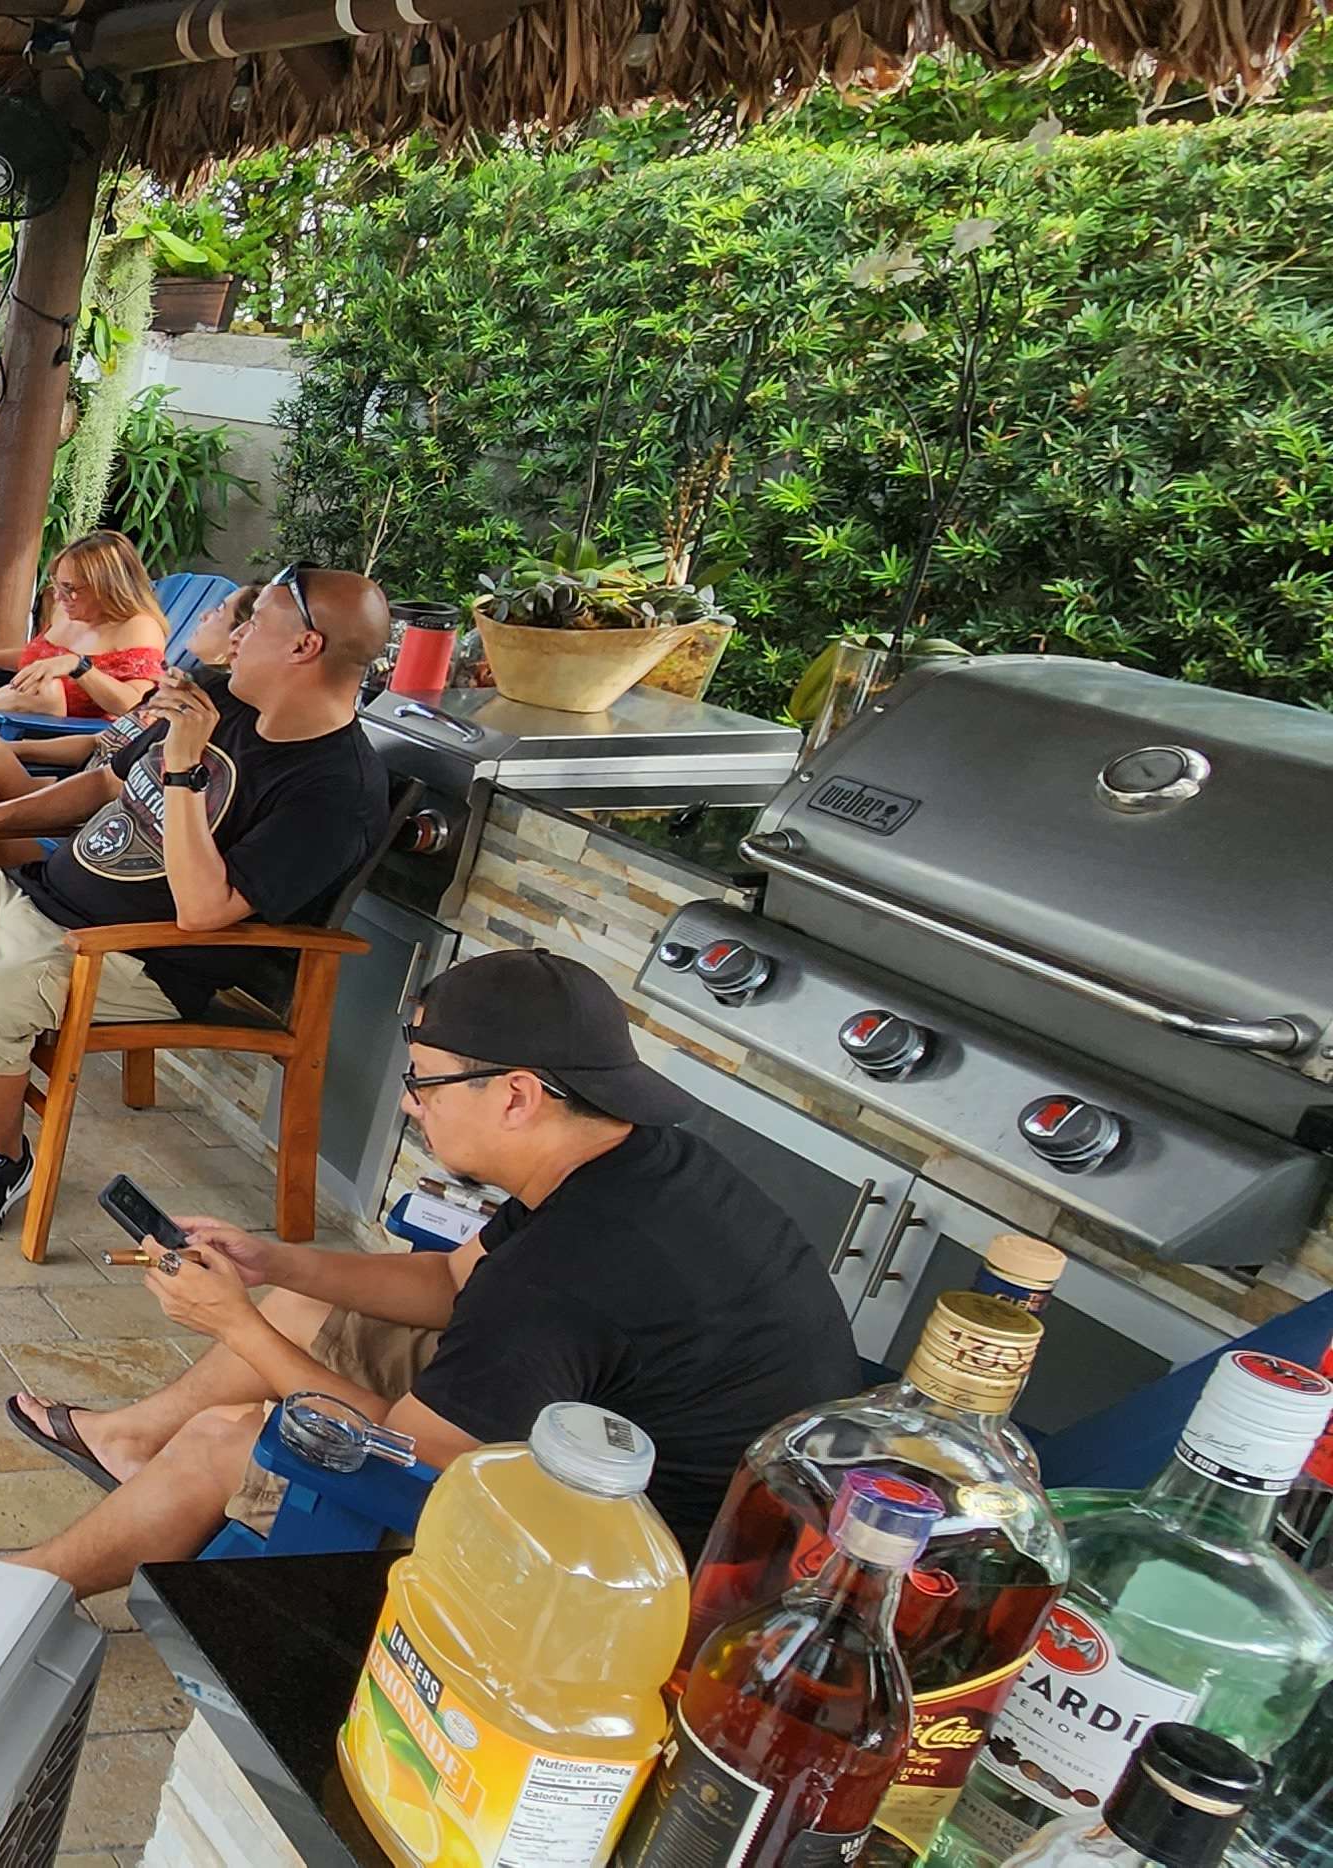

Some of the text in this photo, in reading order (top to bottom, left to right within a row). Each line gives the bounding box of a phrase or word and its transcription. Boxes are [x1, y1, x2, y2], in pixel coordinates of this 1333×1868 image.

[818, 784, 885, 821] weber
[1193, 1455, 1221, 1475] RUM
[390, 1626, 440, 1705] LANGERS
[371, 1646, 463, 1777] EMONADE
[1012, 1692, 1087, 1743] ERIOR
[1017, 1660, 1151, 1744] ARDÍ
[918, 1716, 983, 1749] Caña
[534, 1757, 593, 1774] Nutrition
[595, 1765, 632, 1776] Facts
[524, 1789, 569, 1802] Calories
[592, 1794, 619, 1804] 110
